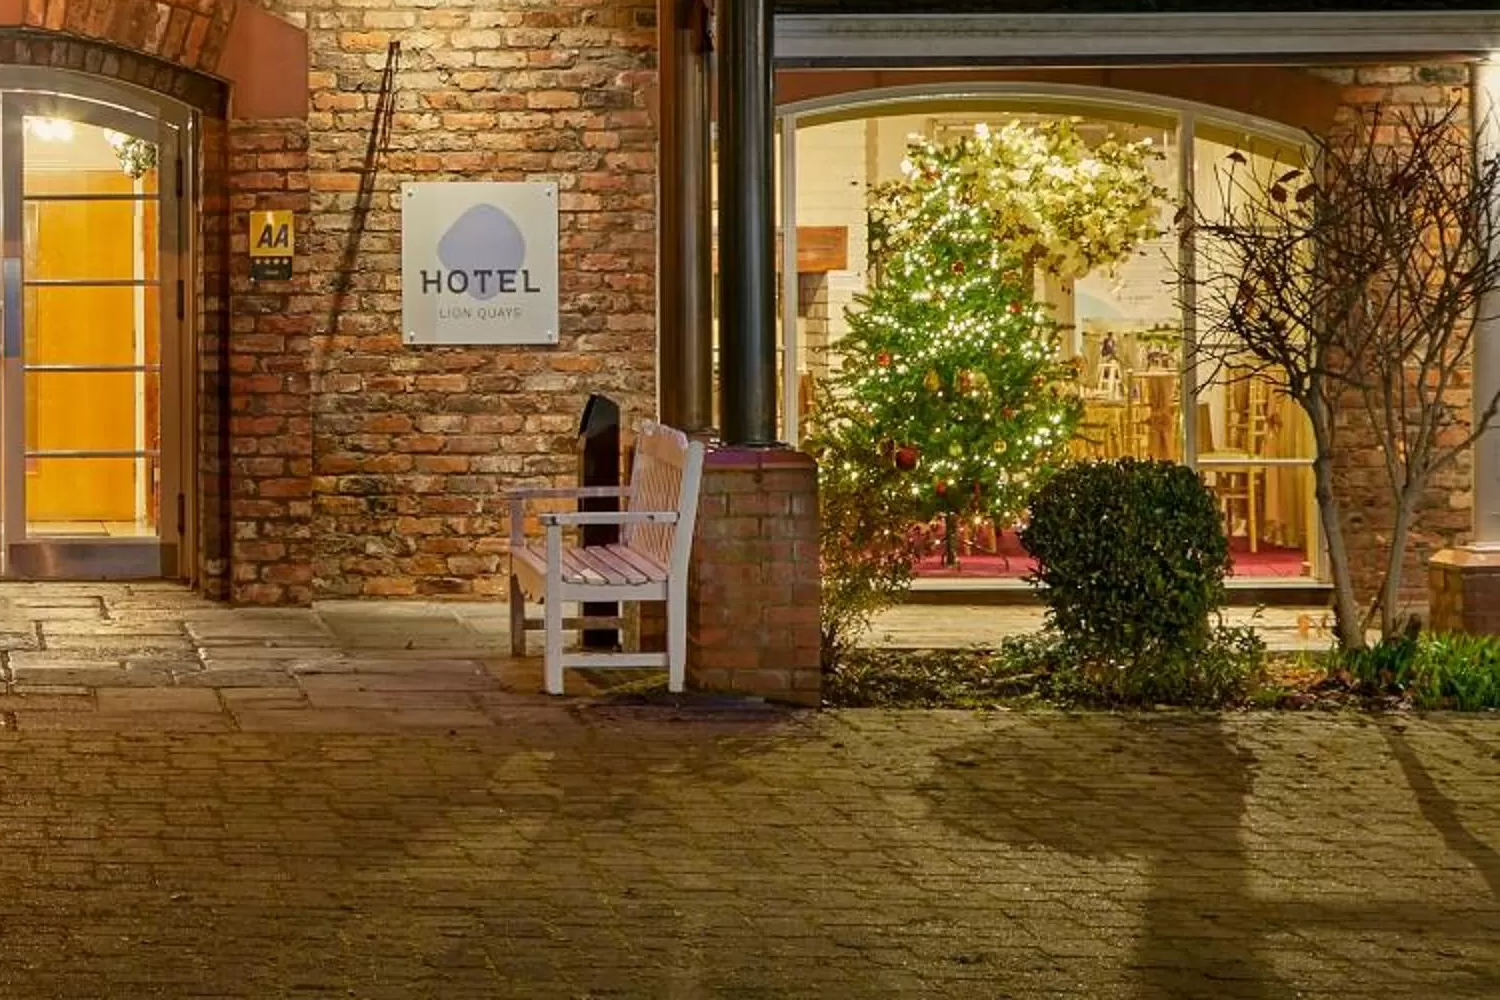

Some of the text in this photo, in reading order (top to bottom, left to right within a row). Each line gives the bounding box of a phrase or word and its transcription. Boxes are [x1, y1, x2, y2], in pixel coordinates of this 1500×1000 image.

[256, 223, 289, 248] AA
[419, 269, 541, 294] HOTEL
[439, 307, 522, 320] LION QUAYS
